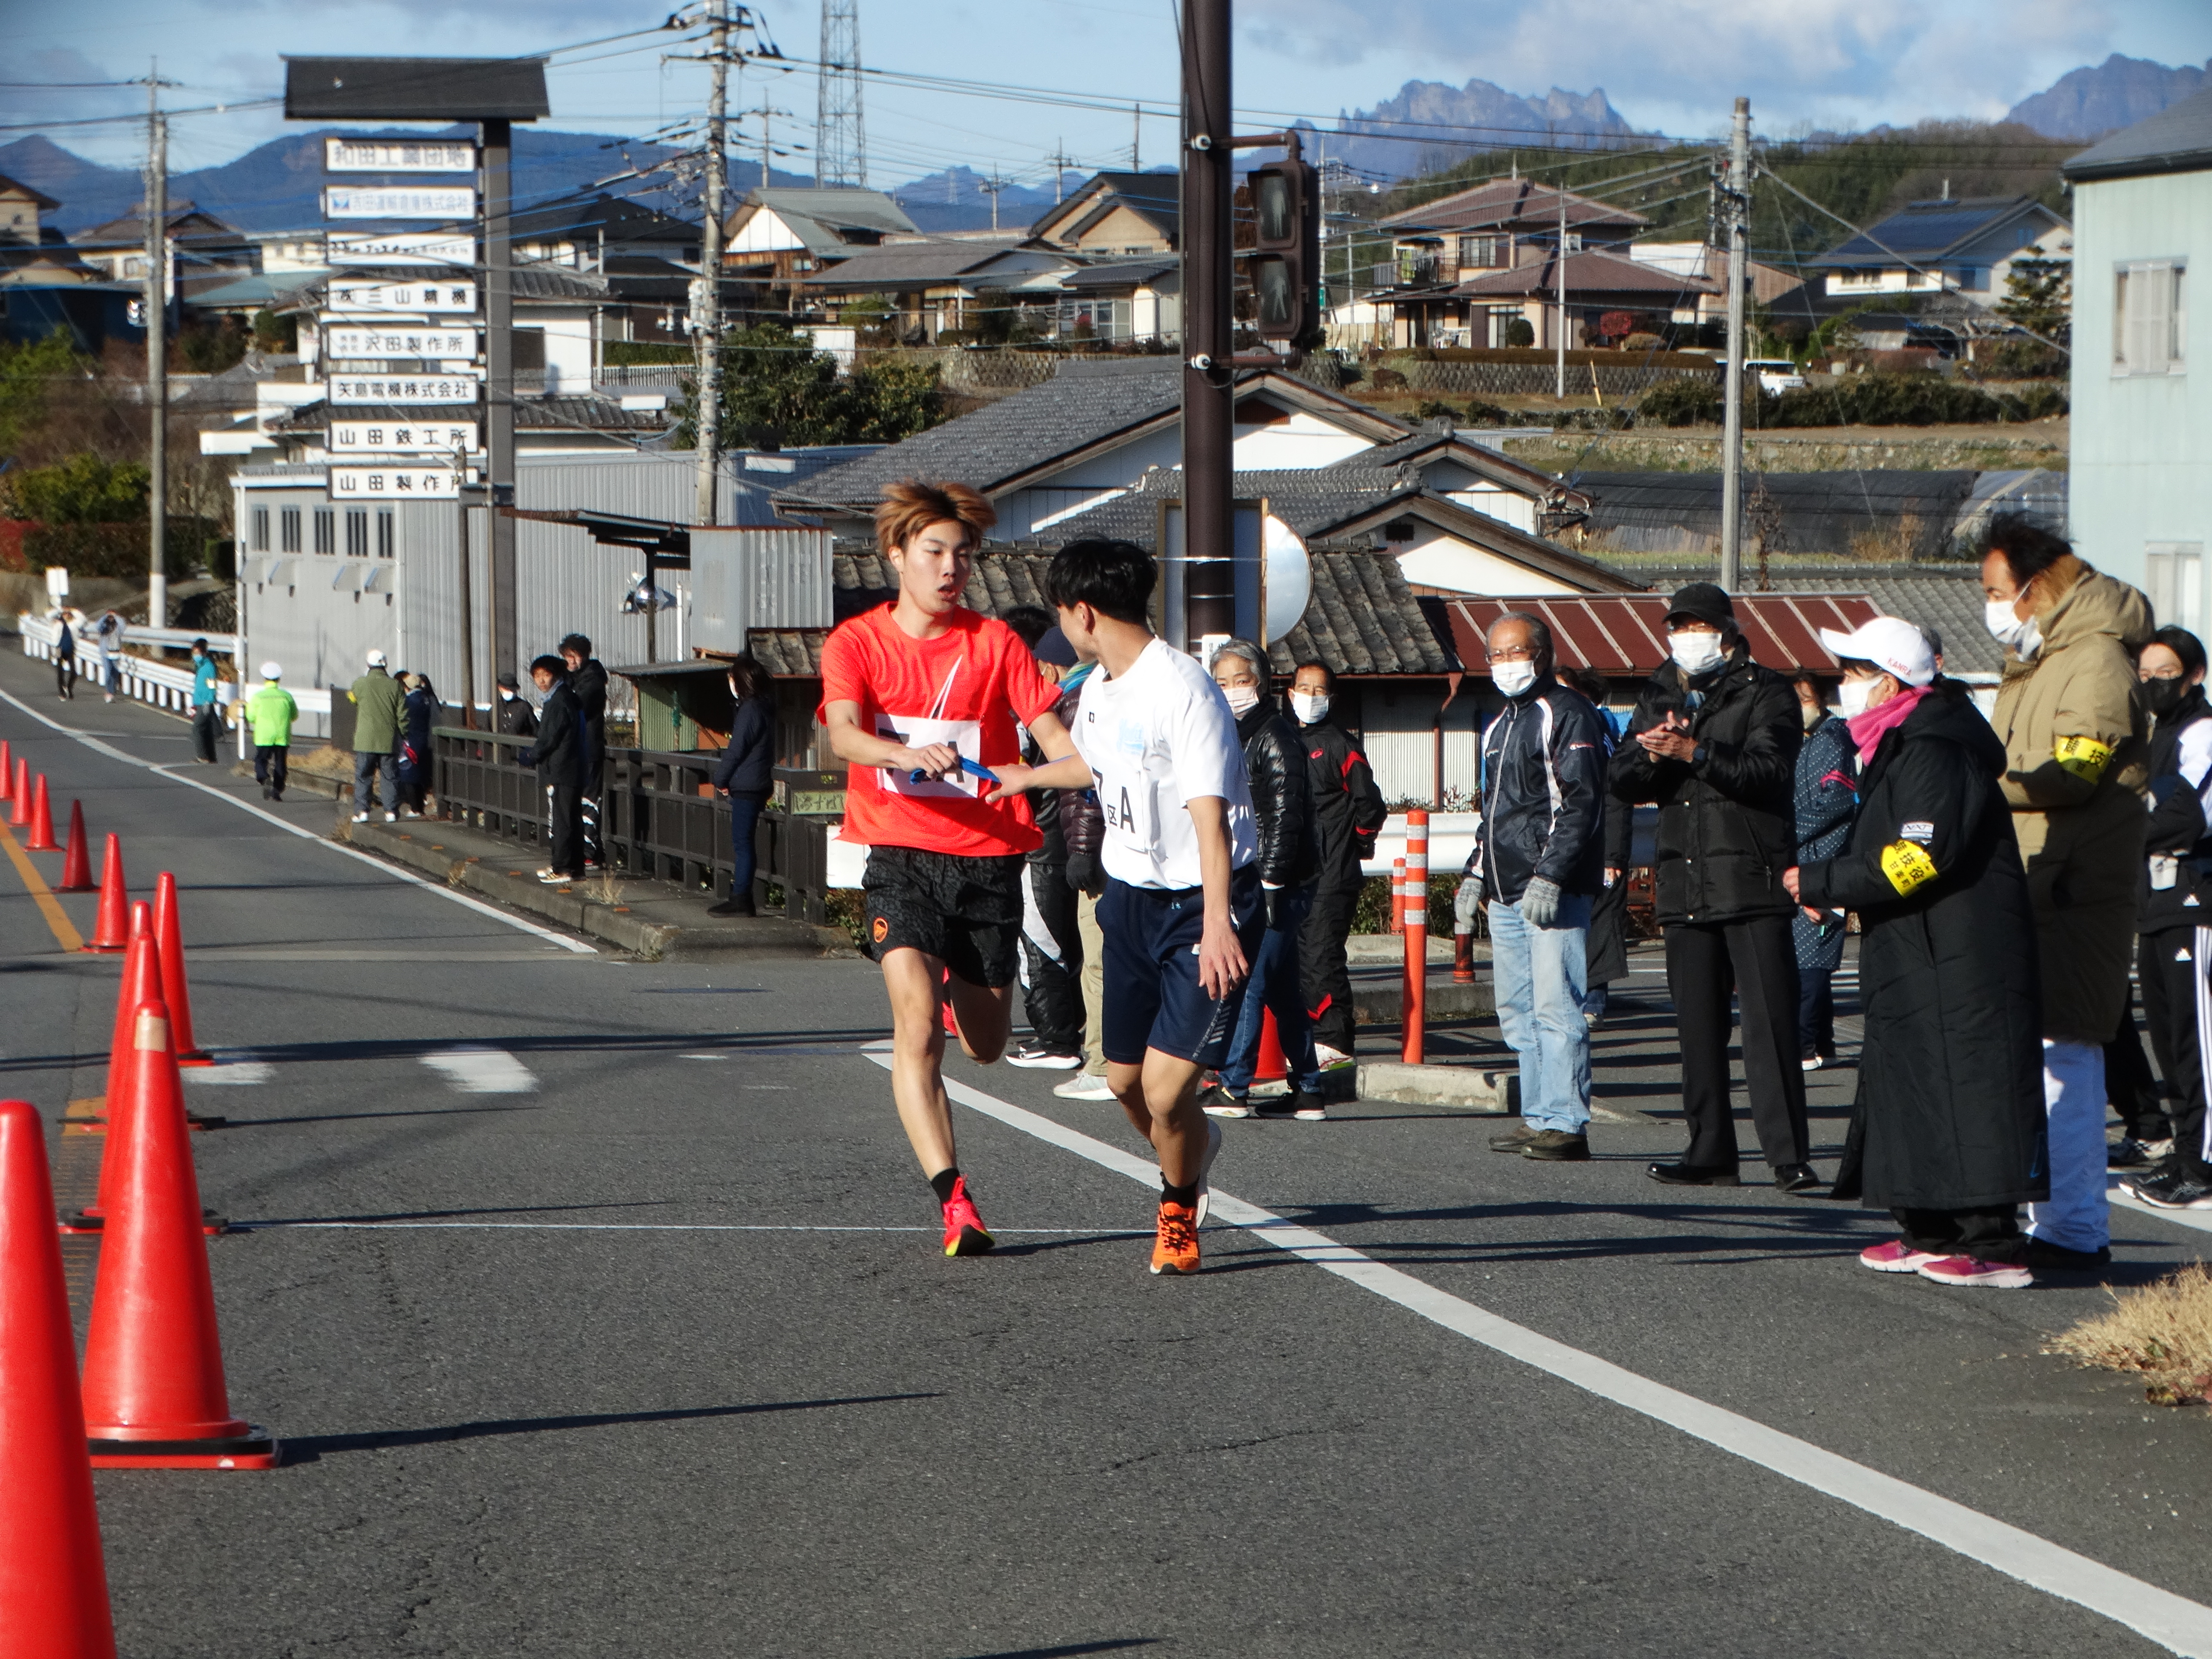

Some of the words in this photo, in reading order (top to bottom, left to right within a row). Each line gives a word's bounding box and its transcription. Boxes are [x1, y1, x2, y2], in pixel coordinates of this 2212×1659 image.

[338, 381, 469, 398] 矢島電機株式会社
[340, 428, 467, 445] 山田鉄工所
